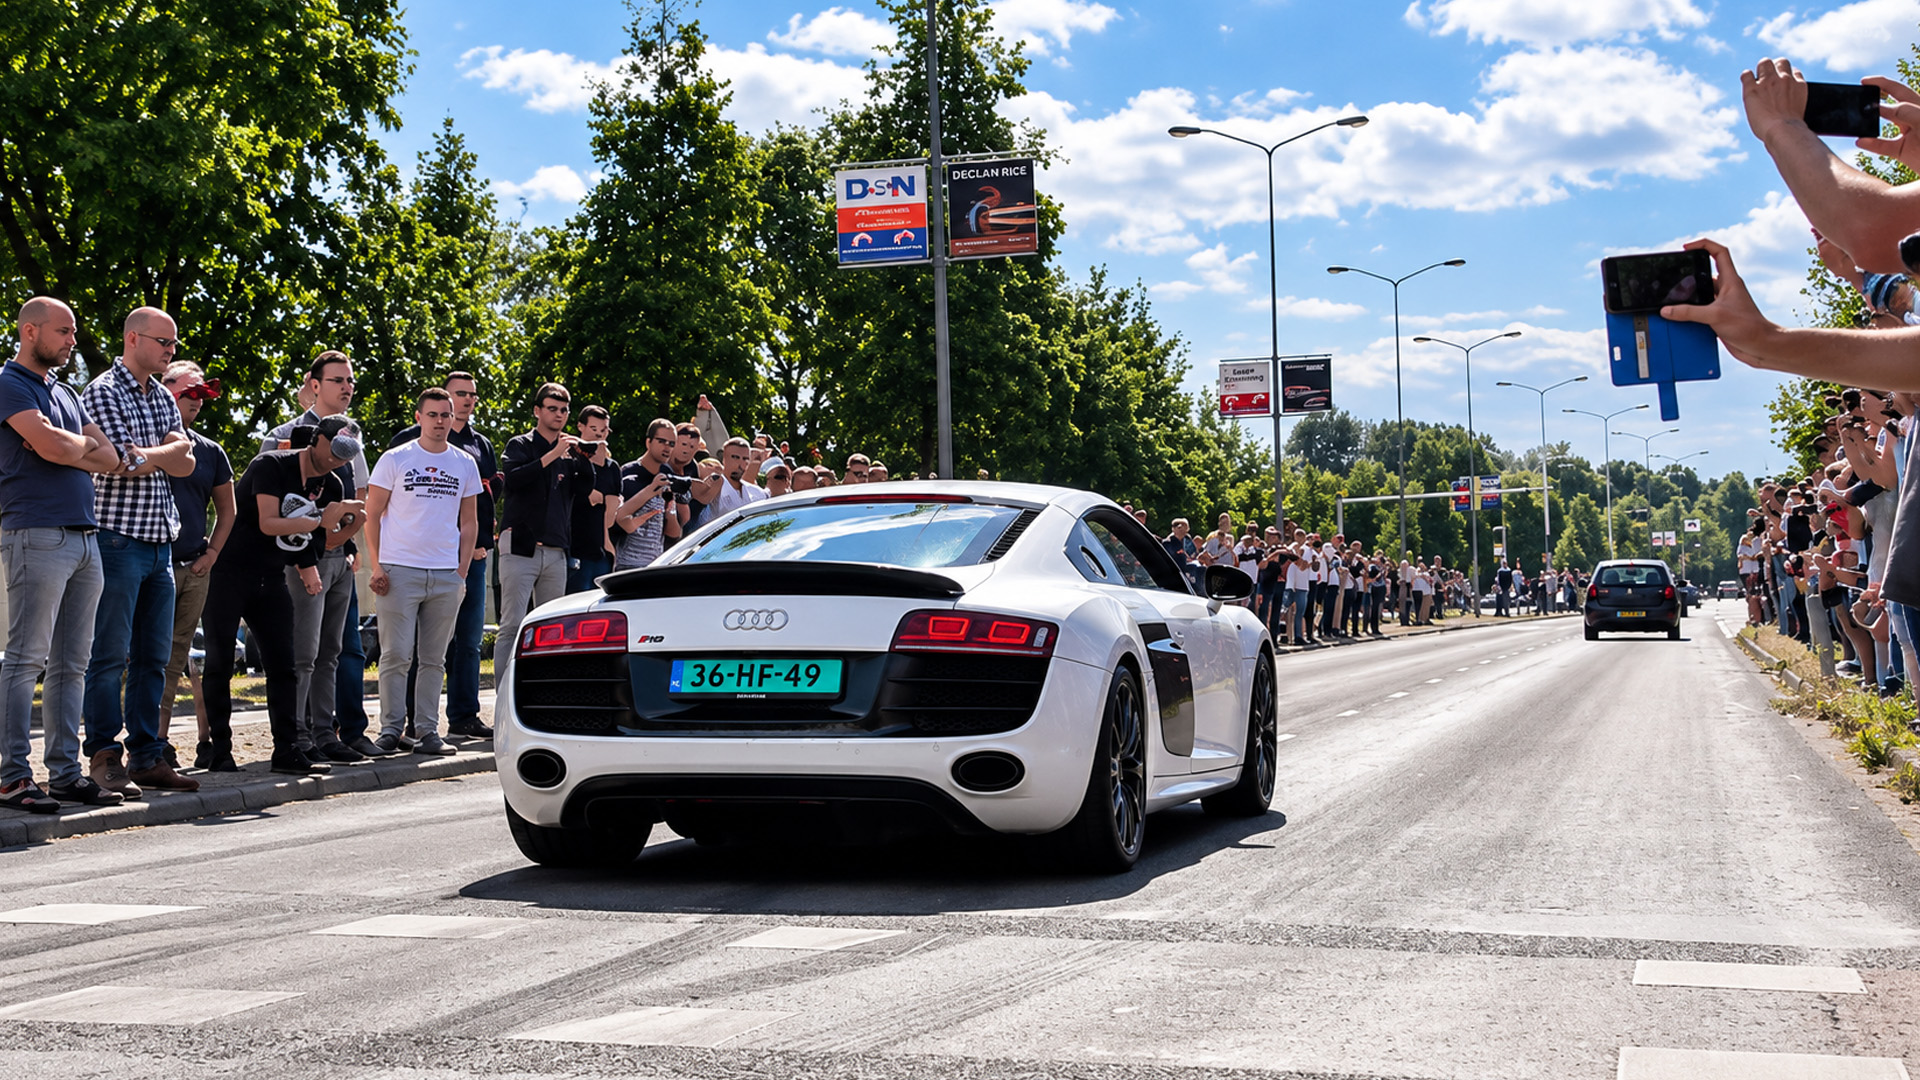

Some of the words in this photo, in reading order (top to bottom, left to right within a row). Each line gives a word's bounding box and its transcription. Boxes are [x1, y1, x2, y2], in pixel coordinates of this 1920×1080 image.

[952, 168, 999, 180] DECLAN
[1001, 166, 1027, 177] RICE
[690, 663, 821, 687] 36-HF-49
